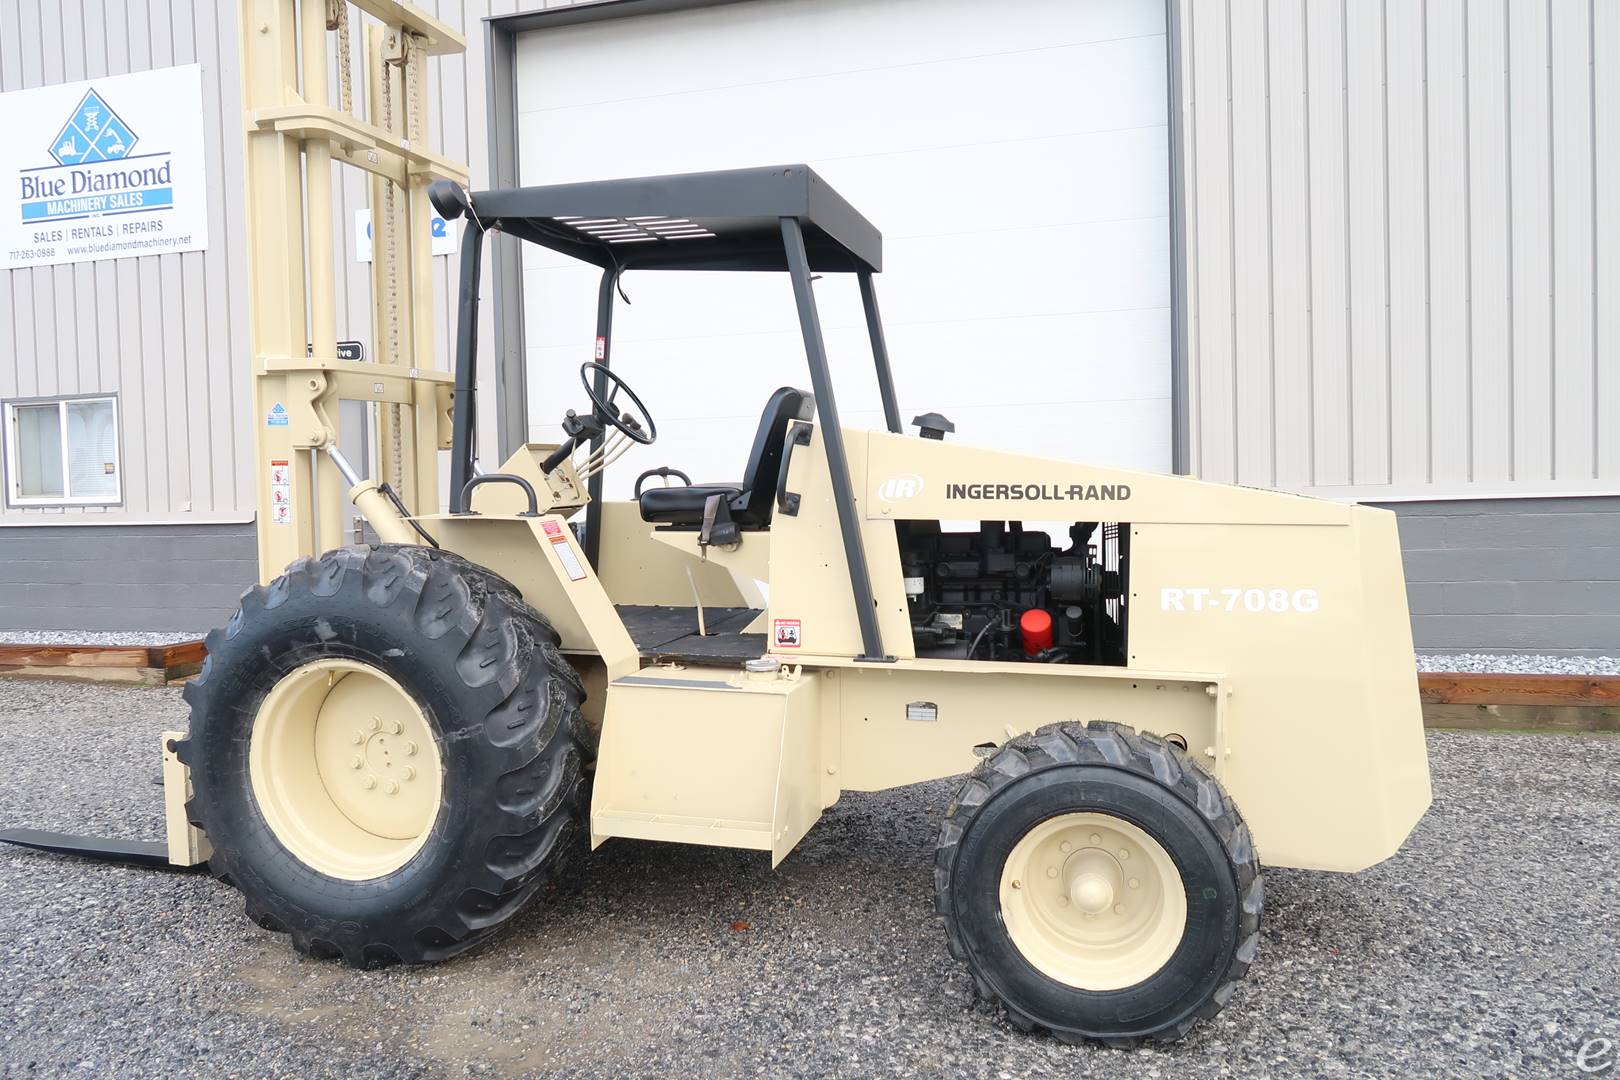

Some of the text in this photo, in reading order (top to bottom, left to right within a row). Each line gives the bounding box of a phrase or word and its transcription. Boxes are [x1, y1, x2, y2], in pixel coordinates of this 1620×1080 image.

[20, 160, 172, 200] Blue Diamond
[47, 192, 144, 215] MACHINERY SALES
[33, 220, 164, 243] SALES RENTALS REPAIRS
[67, 235, 192, 256] www.bluediamondmachinery.net
[946, 483, 1132, 501] INGERSOLL-RAND
[1160, 588, 1319, 613] RT-708G
